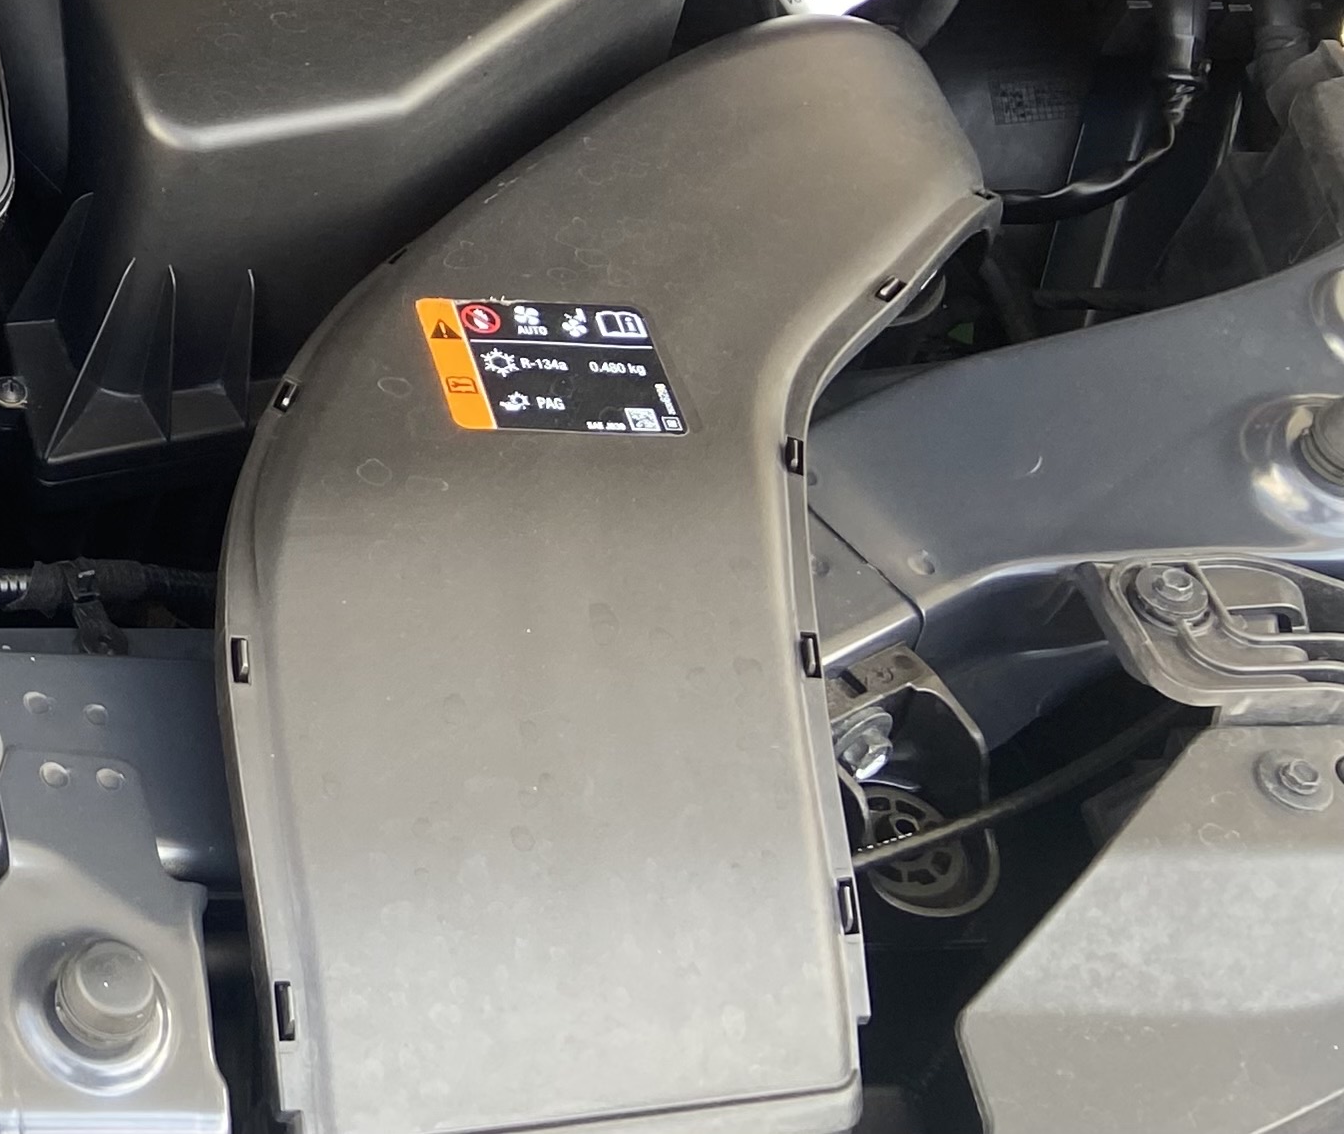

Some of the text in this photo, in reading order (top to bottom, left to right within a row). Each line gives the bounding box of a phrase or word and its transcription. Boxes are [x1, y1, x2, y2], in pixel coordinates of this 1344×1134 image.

[517, 325, 549, 336] AUTO
[520, 357, 569, 371] R-134a
[628, 362, 647, 377] kg
[535, 396, 566, 411] PAG
